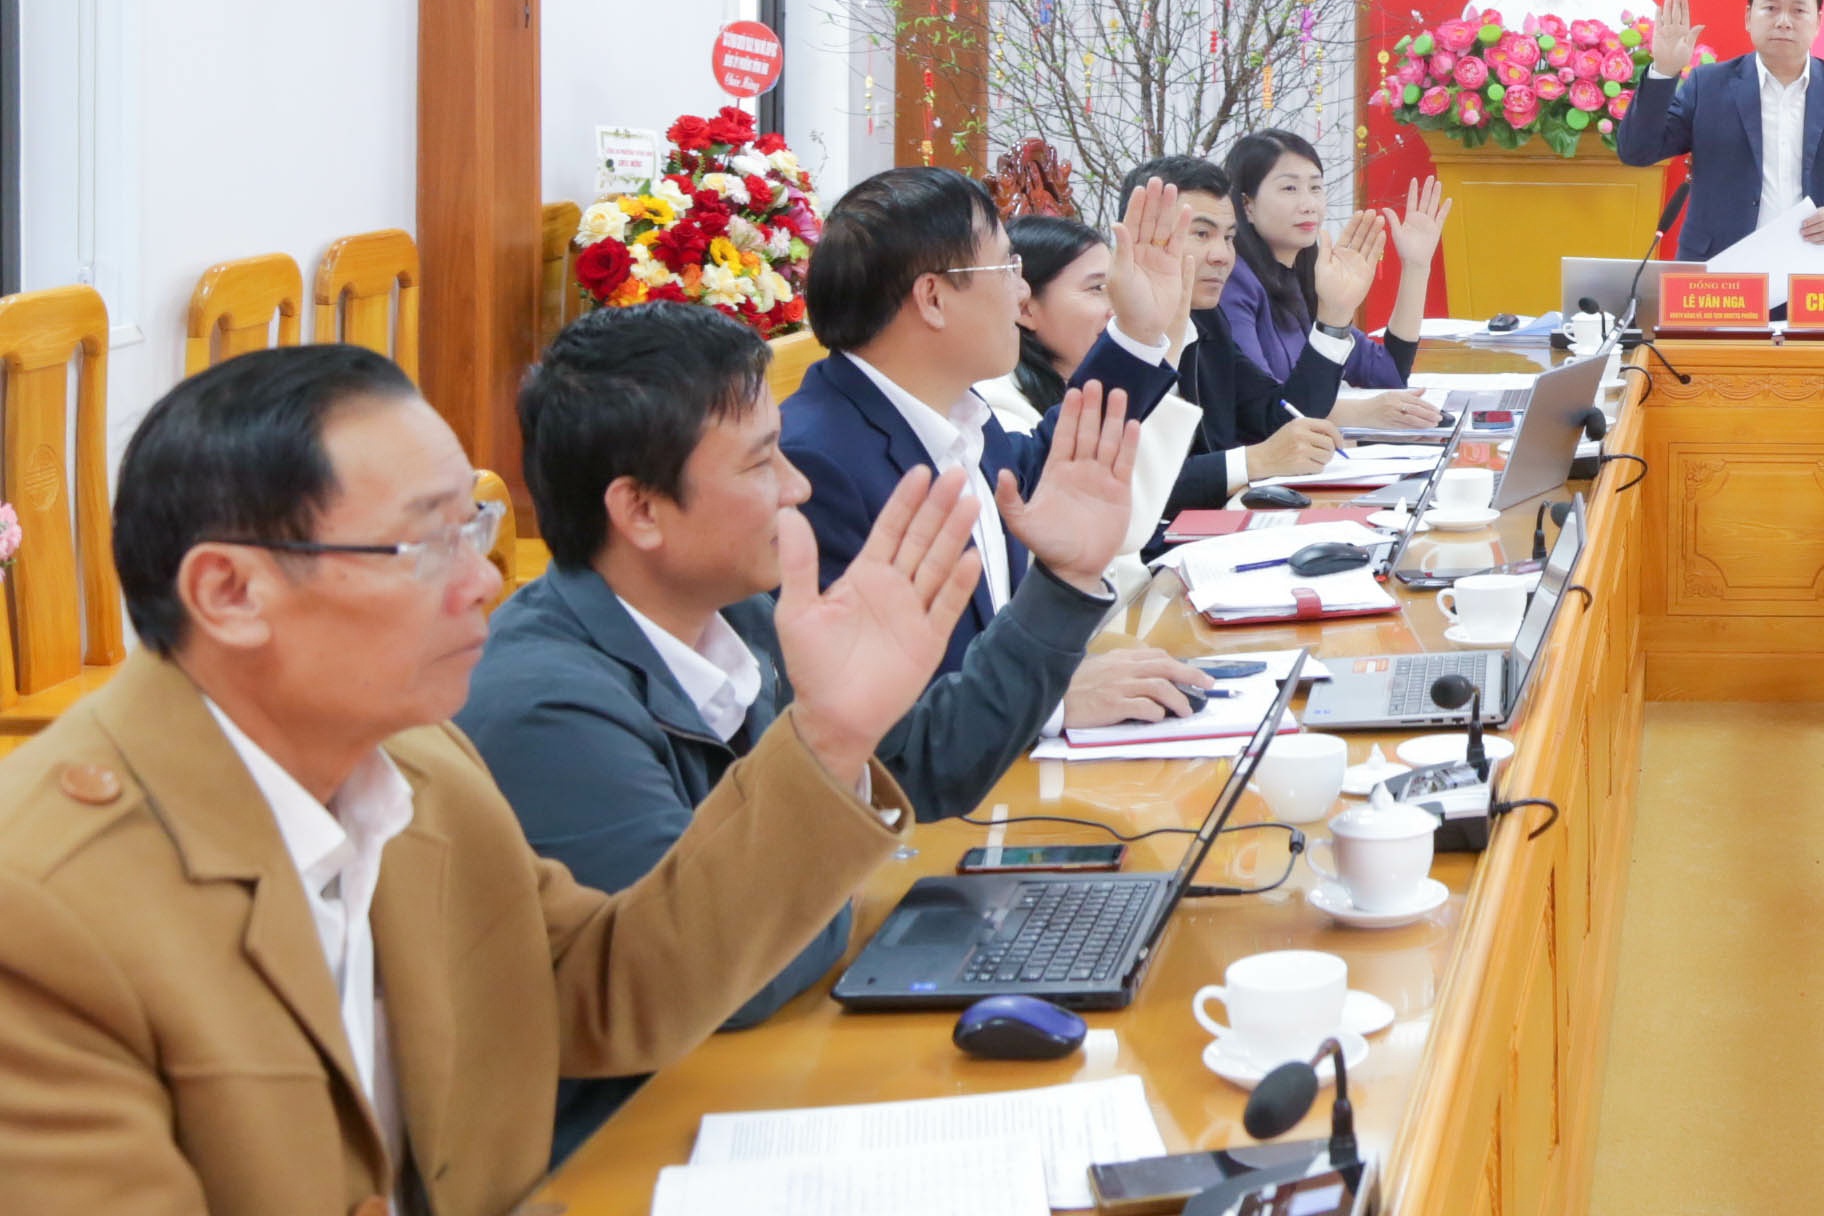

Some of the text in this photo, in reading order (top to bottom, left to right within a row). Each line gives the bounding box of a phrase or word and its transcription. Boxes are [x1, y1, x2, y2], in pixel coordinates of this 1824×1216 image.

[1683, 293, 1746, 308] LÊ VĂN NGA
